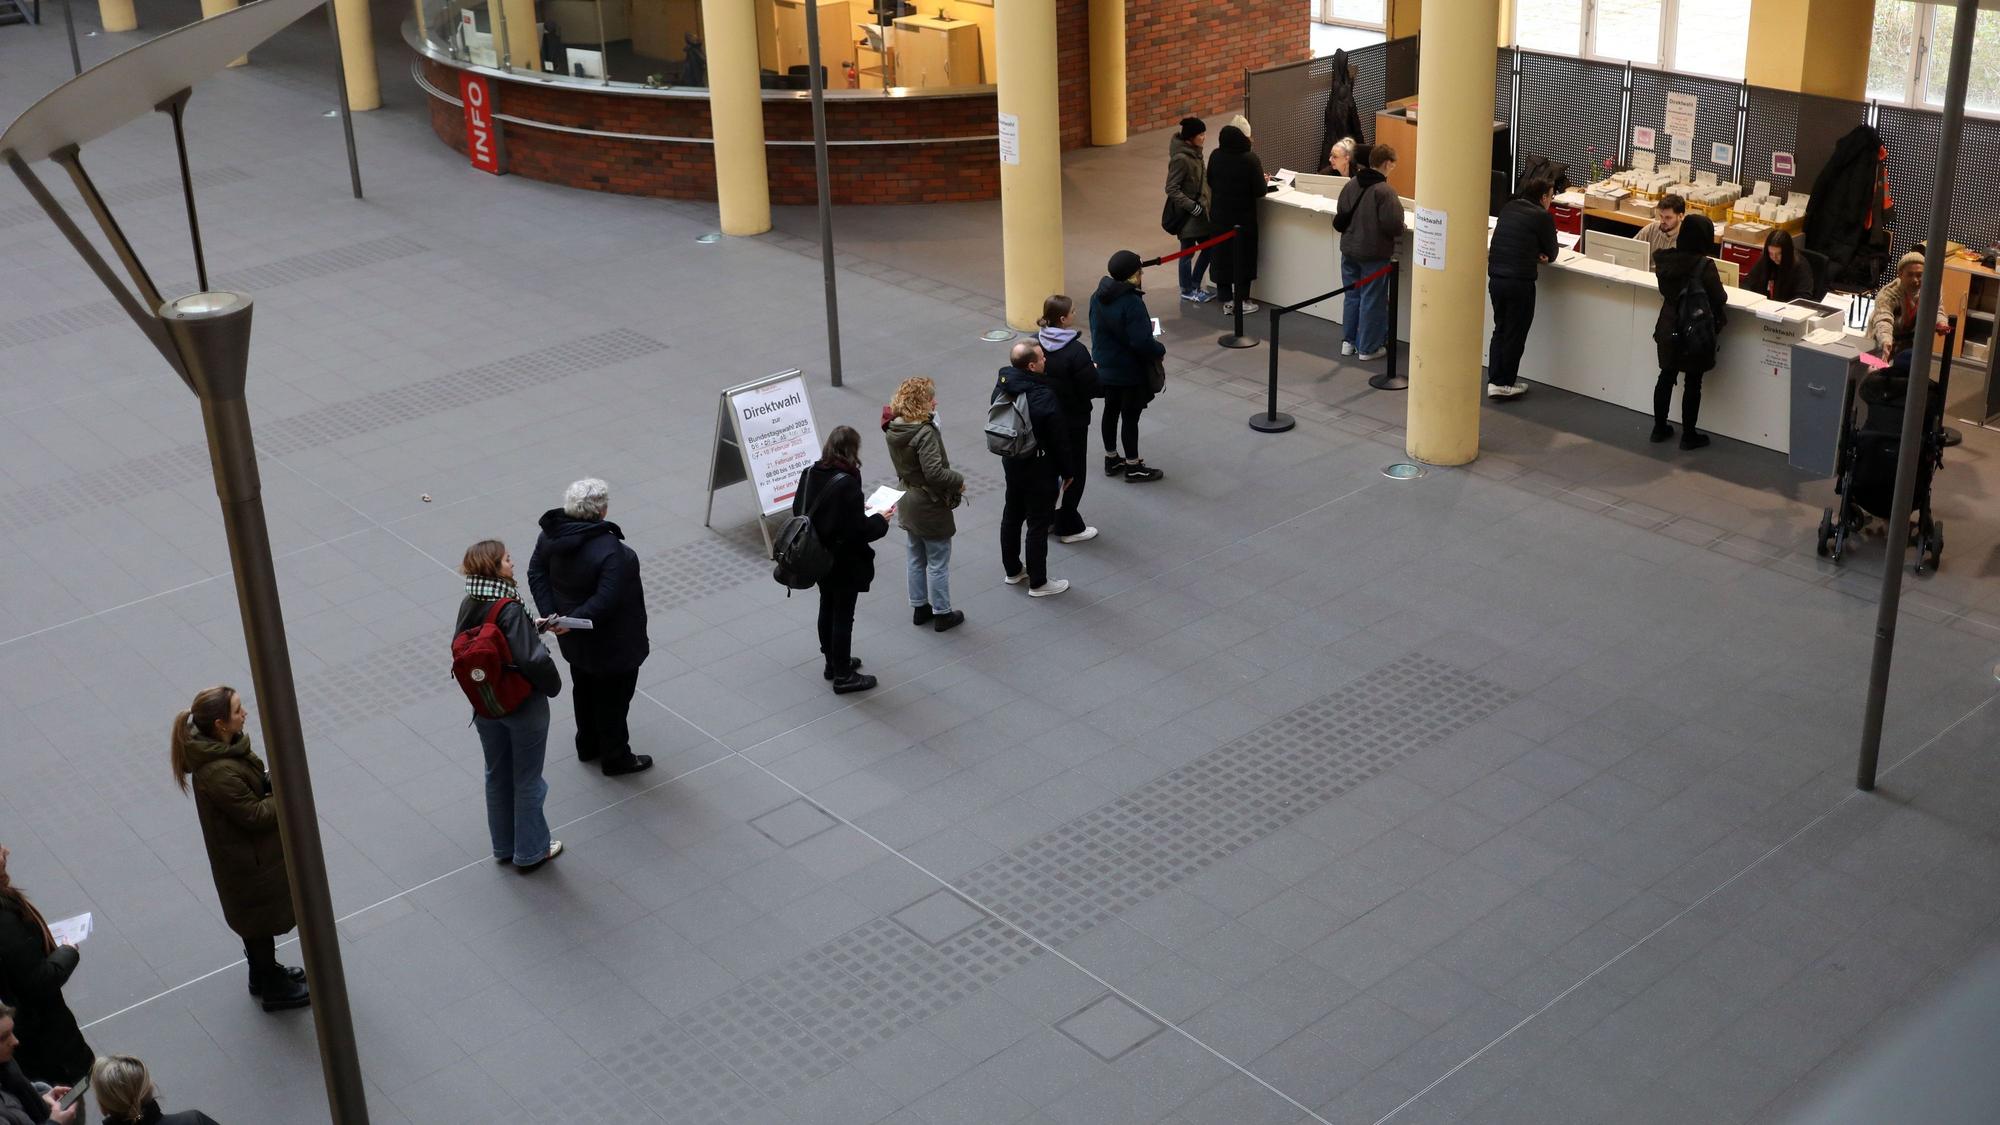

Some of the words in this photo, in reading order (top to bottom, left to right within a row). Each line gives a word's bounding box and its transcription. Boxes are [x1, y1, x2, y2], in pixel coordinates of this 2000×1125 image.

[468, 81, 490, 163] INFO
[743, 392, 801, 420] Direktwahl
[748, 424, 795, 444] Bundestagswahl
[795, 418, 809, 429] 2025
[771, 417, 781, 425] zur
[775, 456, 793, 466] Februar
[794, 451, 807, 460] 2025
[774, 484, 786, 492] Hier
